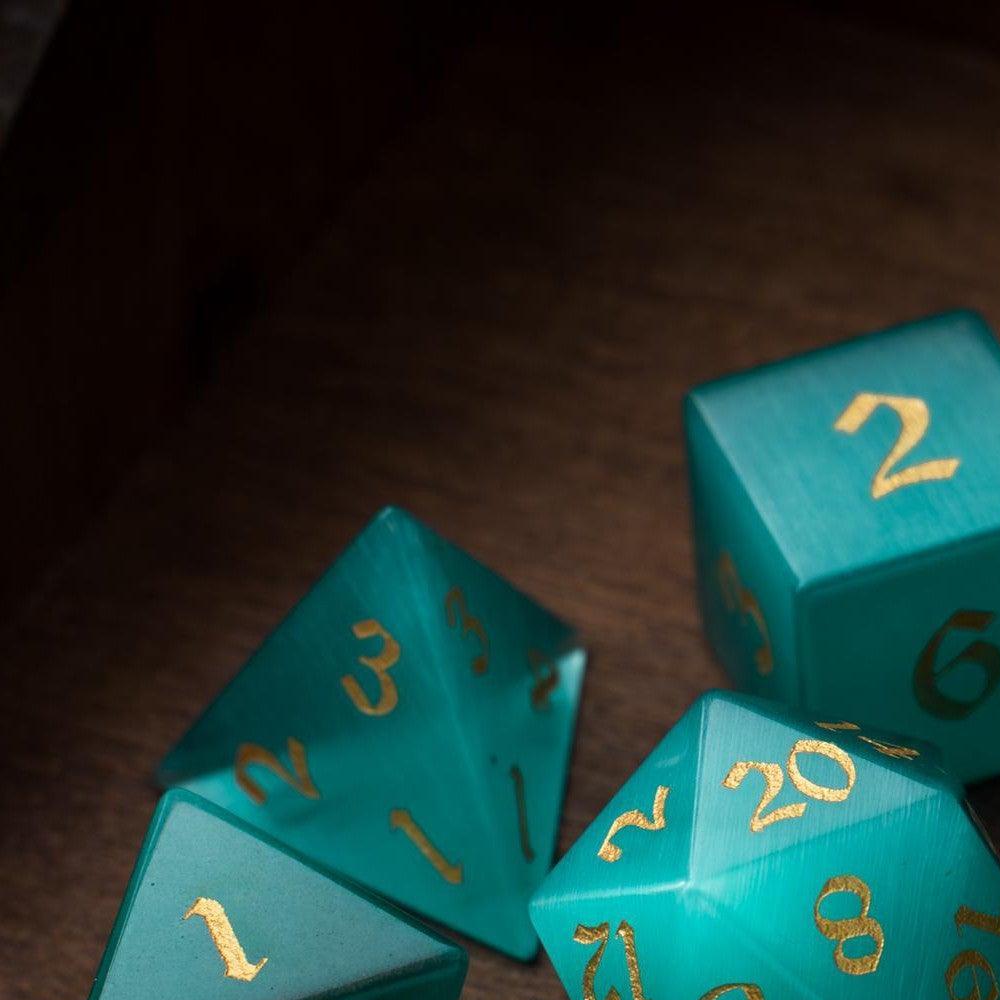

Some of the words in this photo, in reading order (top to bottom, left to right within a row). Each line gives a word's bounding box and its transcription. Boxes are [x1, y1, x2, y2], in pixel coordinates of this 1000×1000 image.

[833, 392, 961, 500] 2
[341, 617, 401, 718] 3
[234, 736, 321, 806] 2
[723, 739, 857, 834] 20
[390, 809, 464, 885] 1
[597, 784, 672, 863] 2
[182, 896, 268, 982] 1
[814, 873, 885, 977] 8
